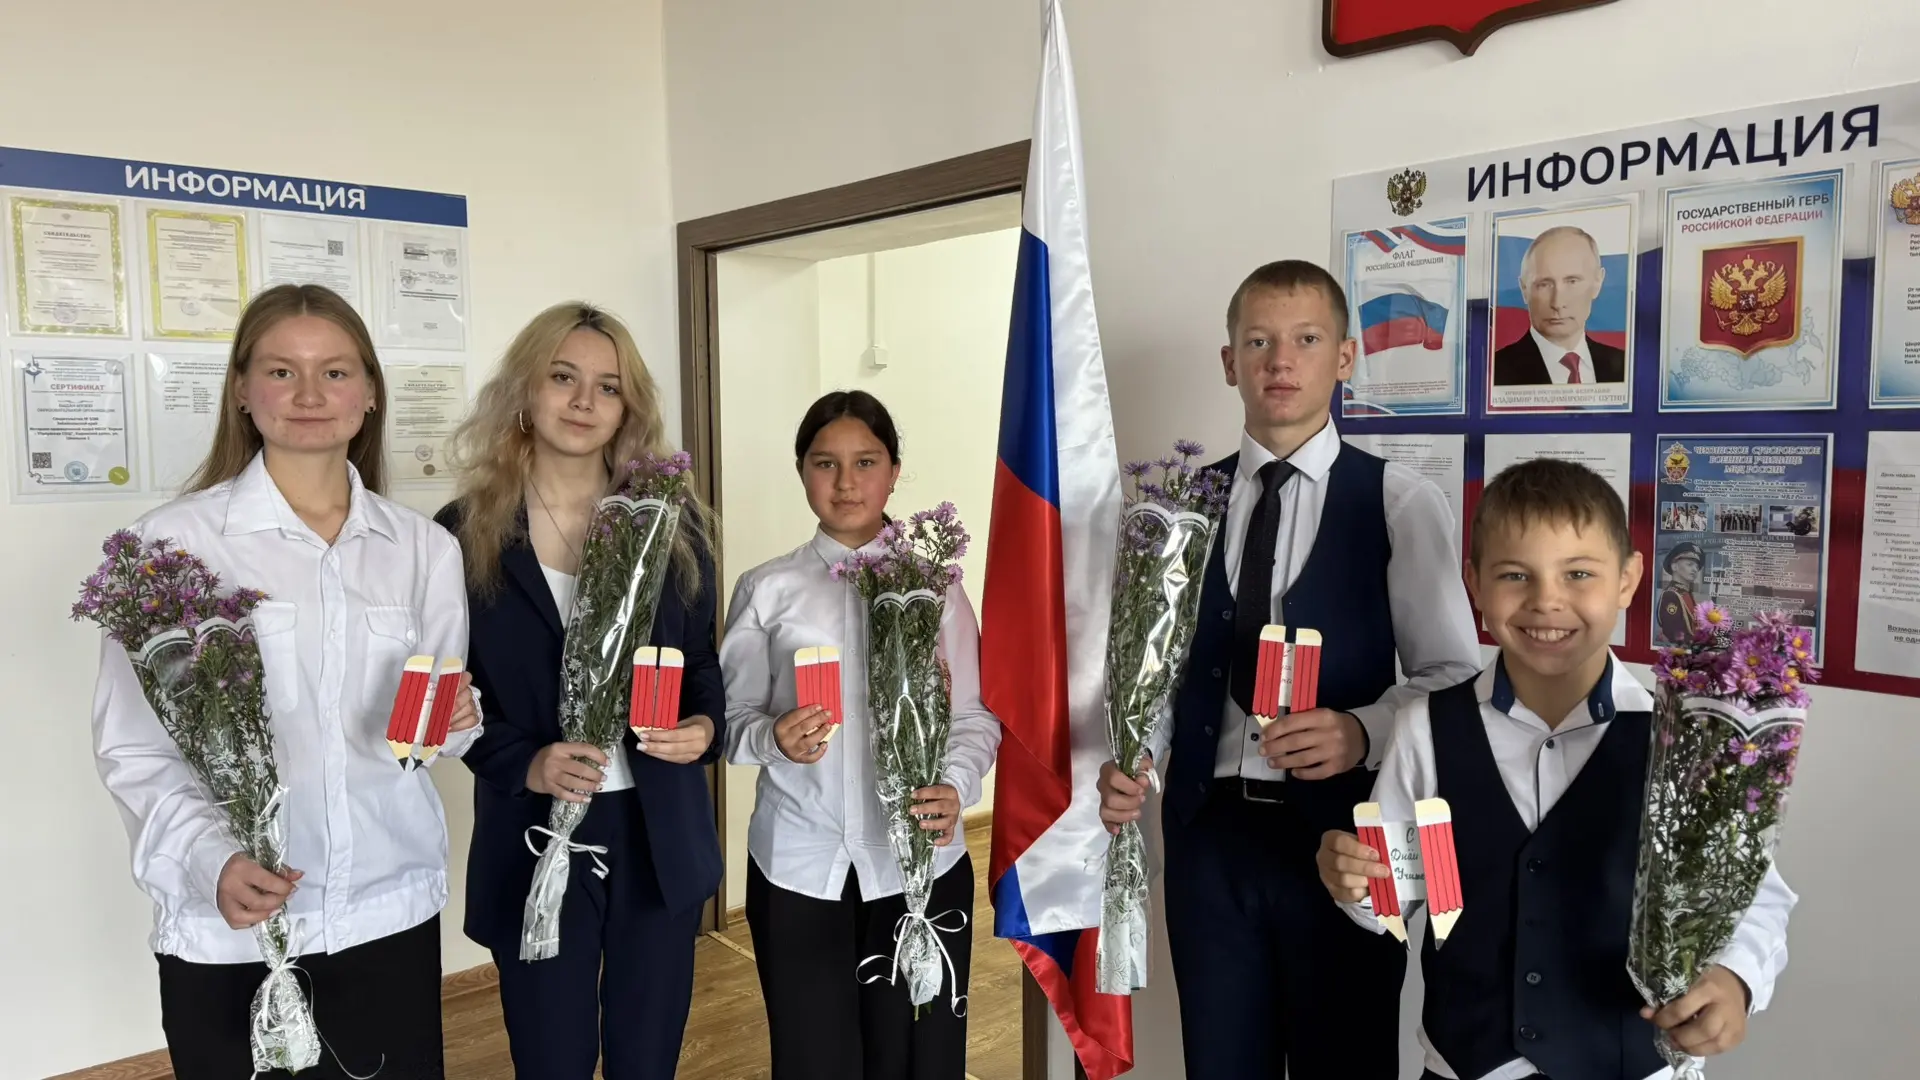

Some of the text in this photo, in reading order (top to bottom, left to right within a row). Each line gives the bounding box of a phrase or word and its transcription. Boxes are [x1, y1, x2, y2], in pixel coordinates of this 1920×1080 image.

[1468, 104, 1881, 202] ИНФОРМАЦИЯ
[125, 165, 366, 211] ИНФОРМАЦИЯ
[1677, 193, 1830, 220] ГОСУДАРСТВЕННЫЙ ГЕРБ
[1681, 210, 1823, 233] РОССИЙСКОЙ ФЕДЕРАЦИИ
[1392, 249, 1416, 260] ФЛАГ
[50, 383, 105, 391] СЕРТИФИКАТ
